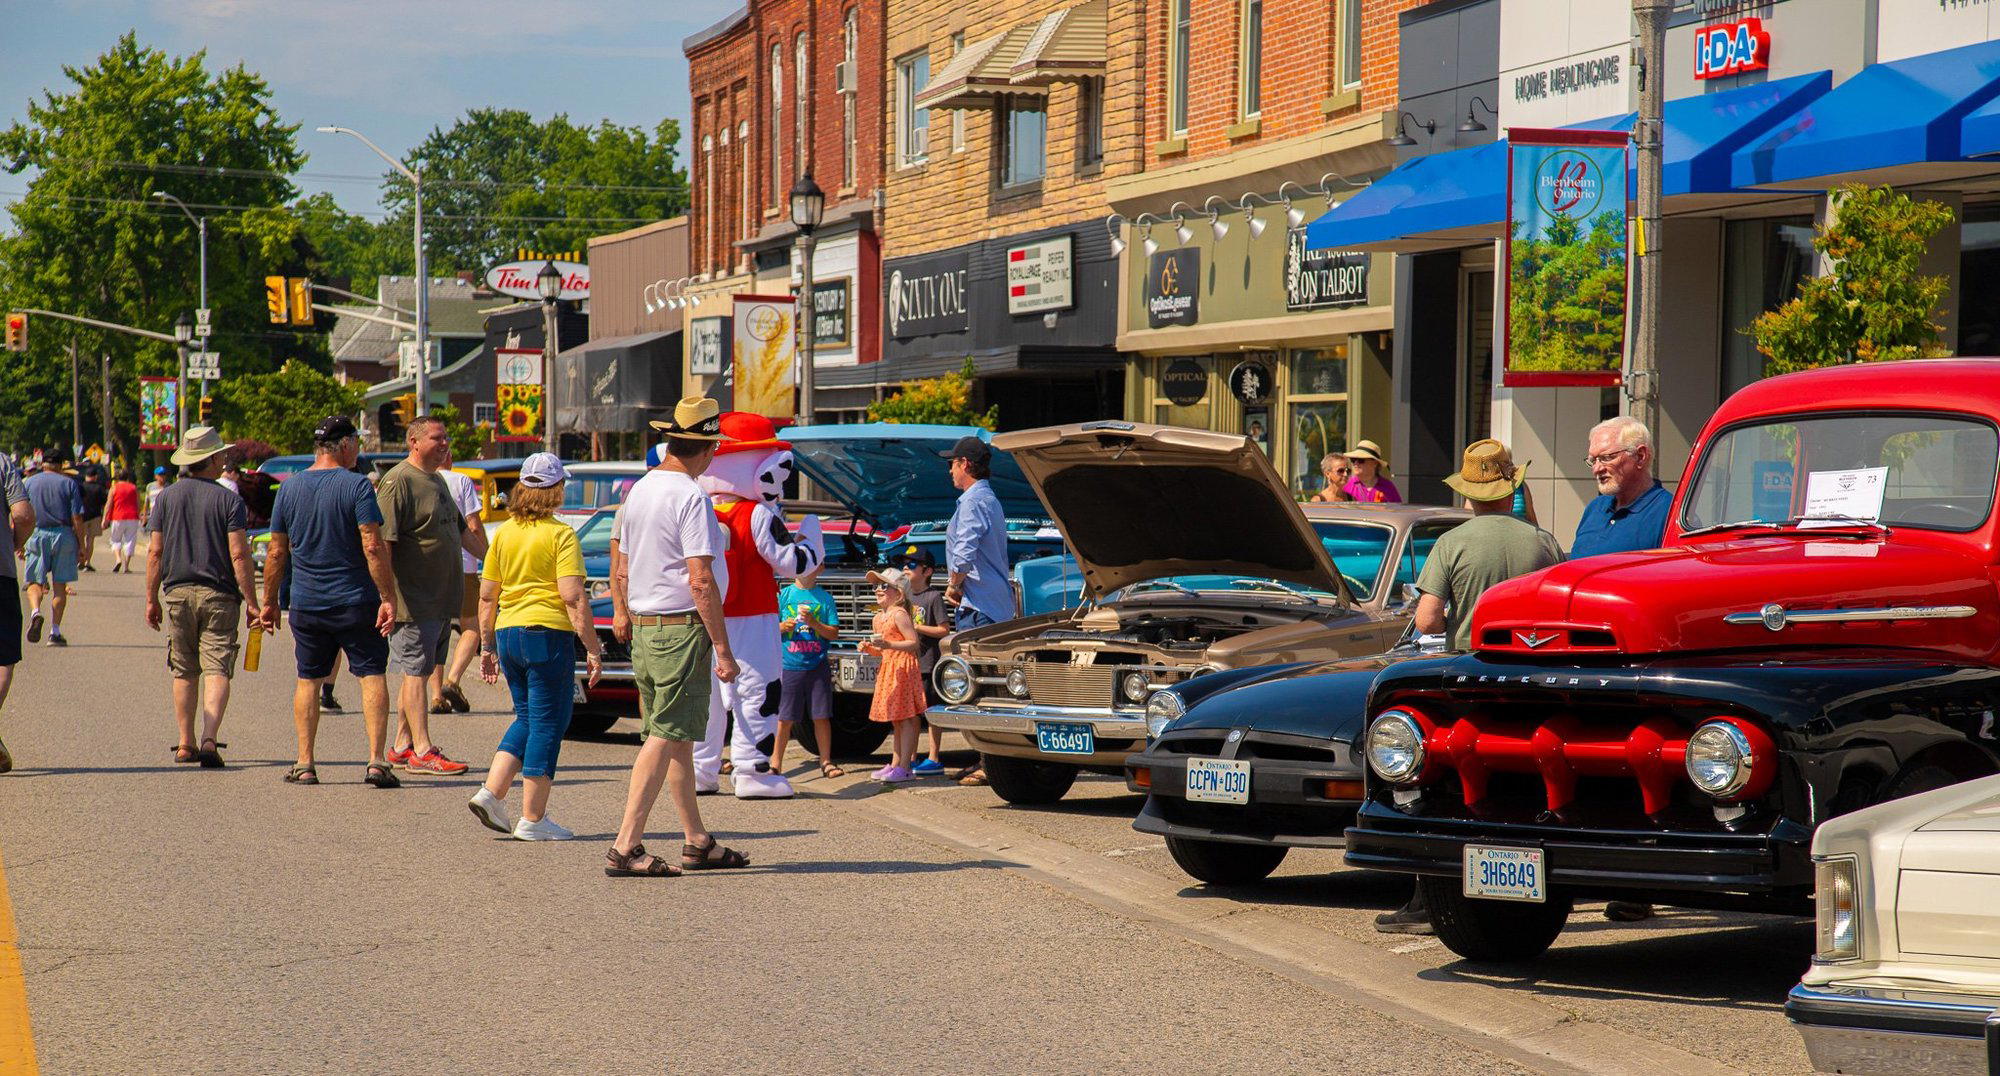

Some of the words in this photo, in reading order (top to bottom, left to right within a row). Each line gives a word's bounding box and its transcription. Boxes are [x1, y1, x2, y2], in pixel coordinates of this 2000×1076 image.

[1515, 71, 1547, 101] HOME
[1550, 55, 1619, 95] HEALTHCARE
[1541, 175, 1595, 188] Blenheim
[1554, 188, 1595, 199] Ontario
[497, 268, 531, 289] Tim
[1301, 270, 1318, 299] ON
[1320, 266, 1365, 297] TALBOT
[814, 290, 838, 313] CENTURY
[900, 275, 939, 321] SIXTY
[940, 269, 966, 316] ONE
[1164, 371, 1207, 382] OPTICAL
[787, 640, 822, 653] JAWS
[1456, 675, 1609, 687] MERCURY
[1480, 860, 1535, 888] 3H6849
